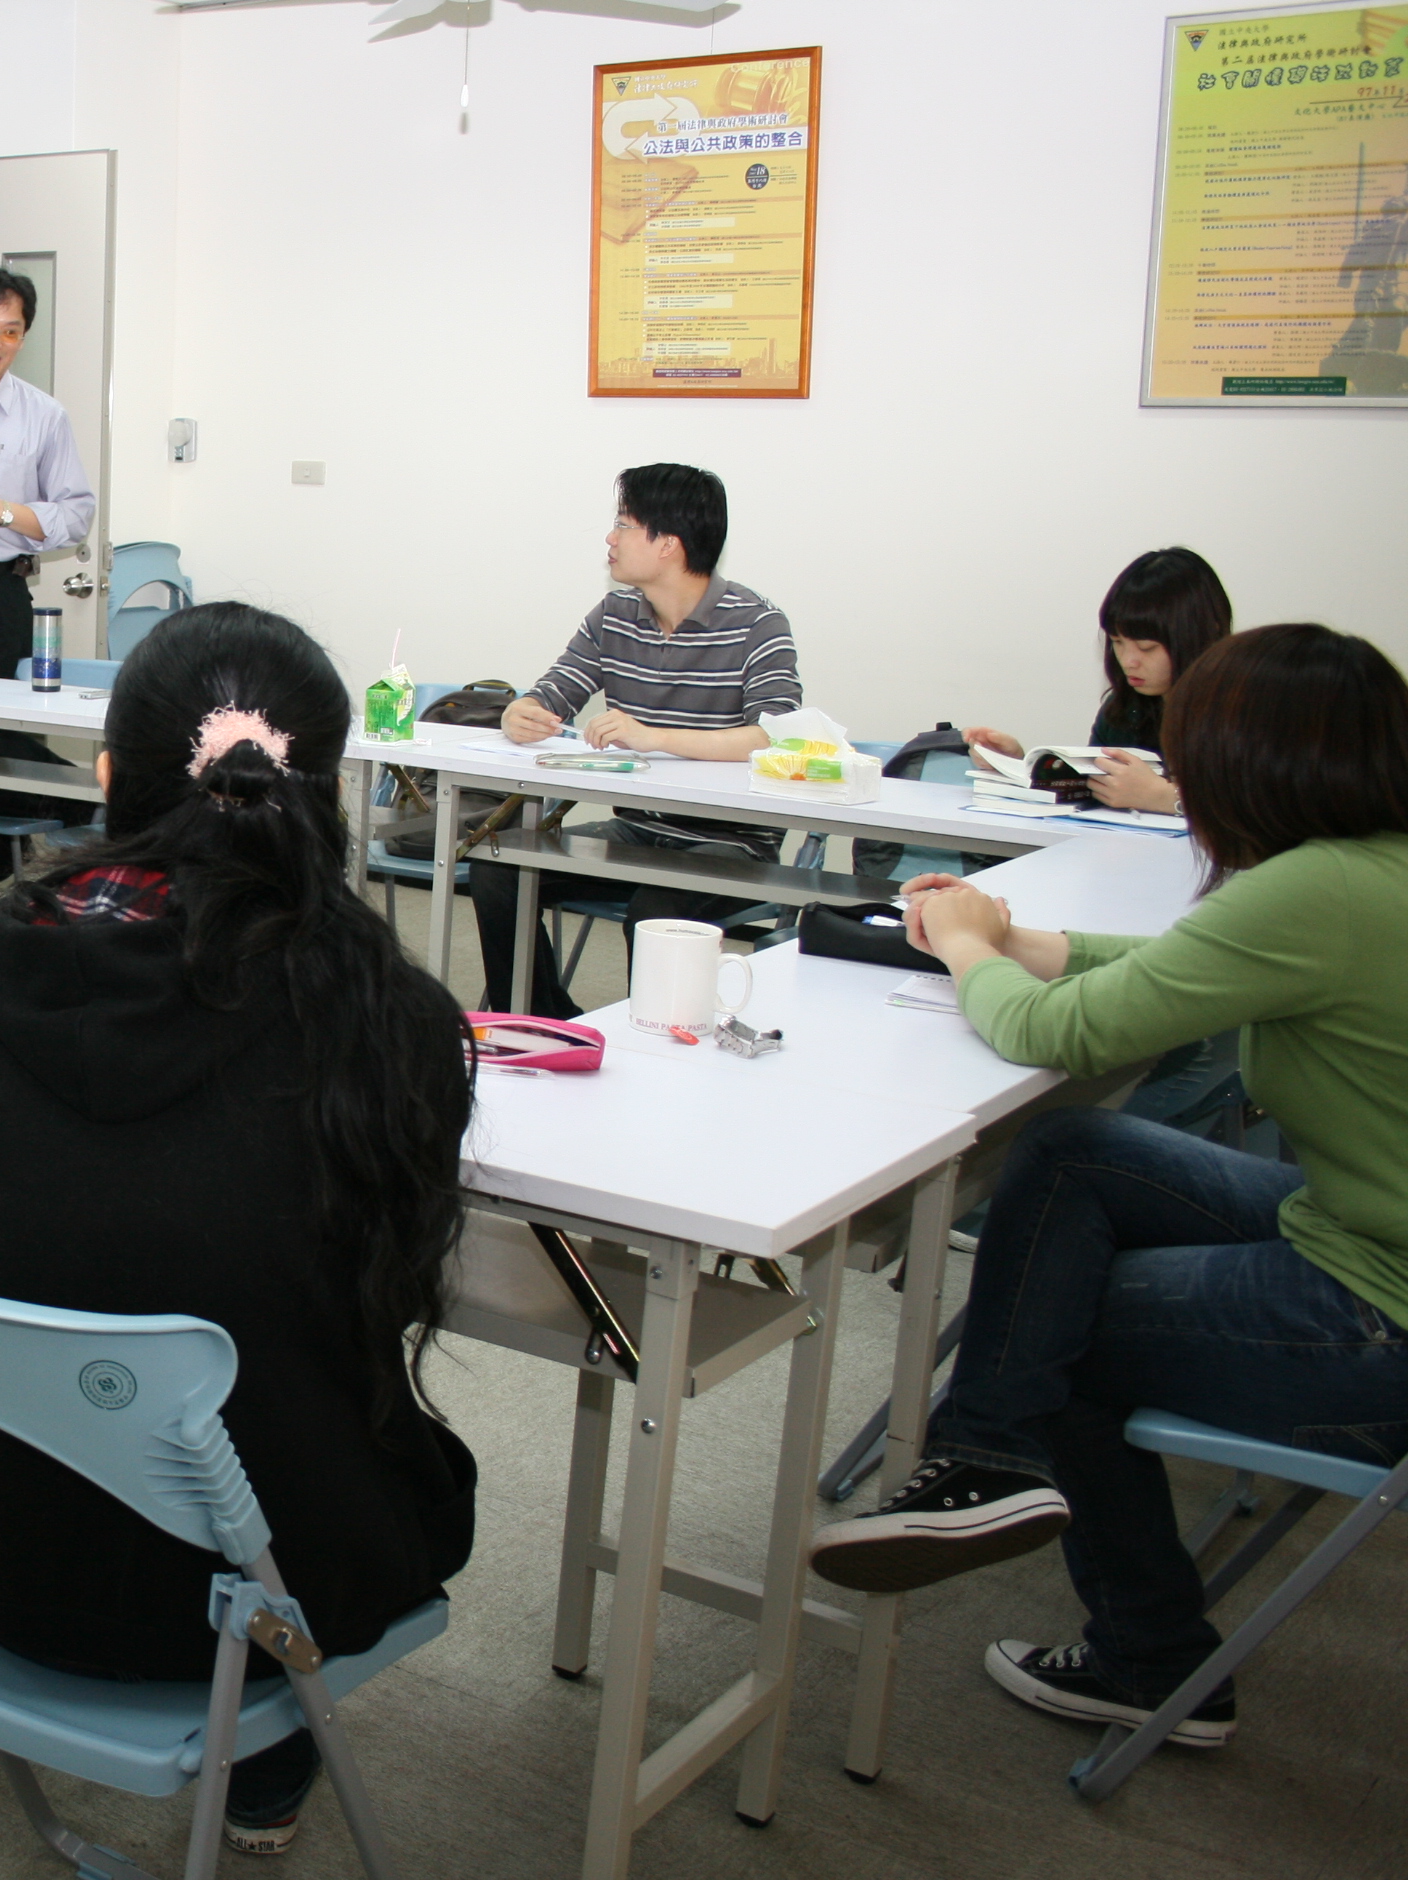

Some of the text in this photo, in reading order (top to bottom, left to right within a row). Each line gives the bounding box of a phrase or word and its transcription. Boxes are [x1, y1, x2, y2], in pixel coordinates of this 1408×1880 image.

[730, 58, 809, 73] Conference
[658, 114, 788, 133] 第一屆法律與政府學術研討會
[644, 131, 803, 156] 公法與公共政策的整合
[687, 1023, 707, 1031] PASTA
[237, 1837, 275, 1851] ALL STAR
